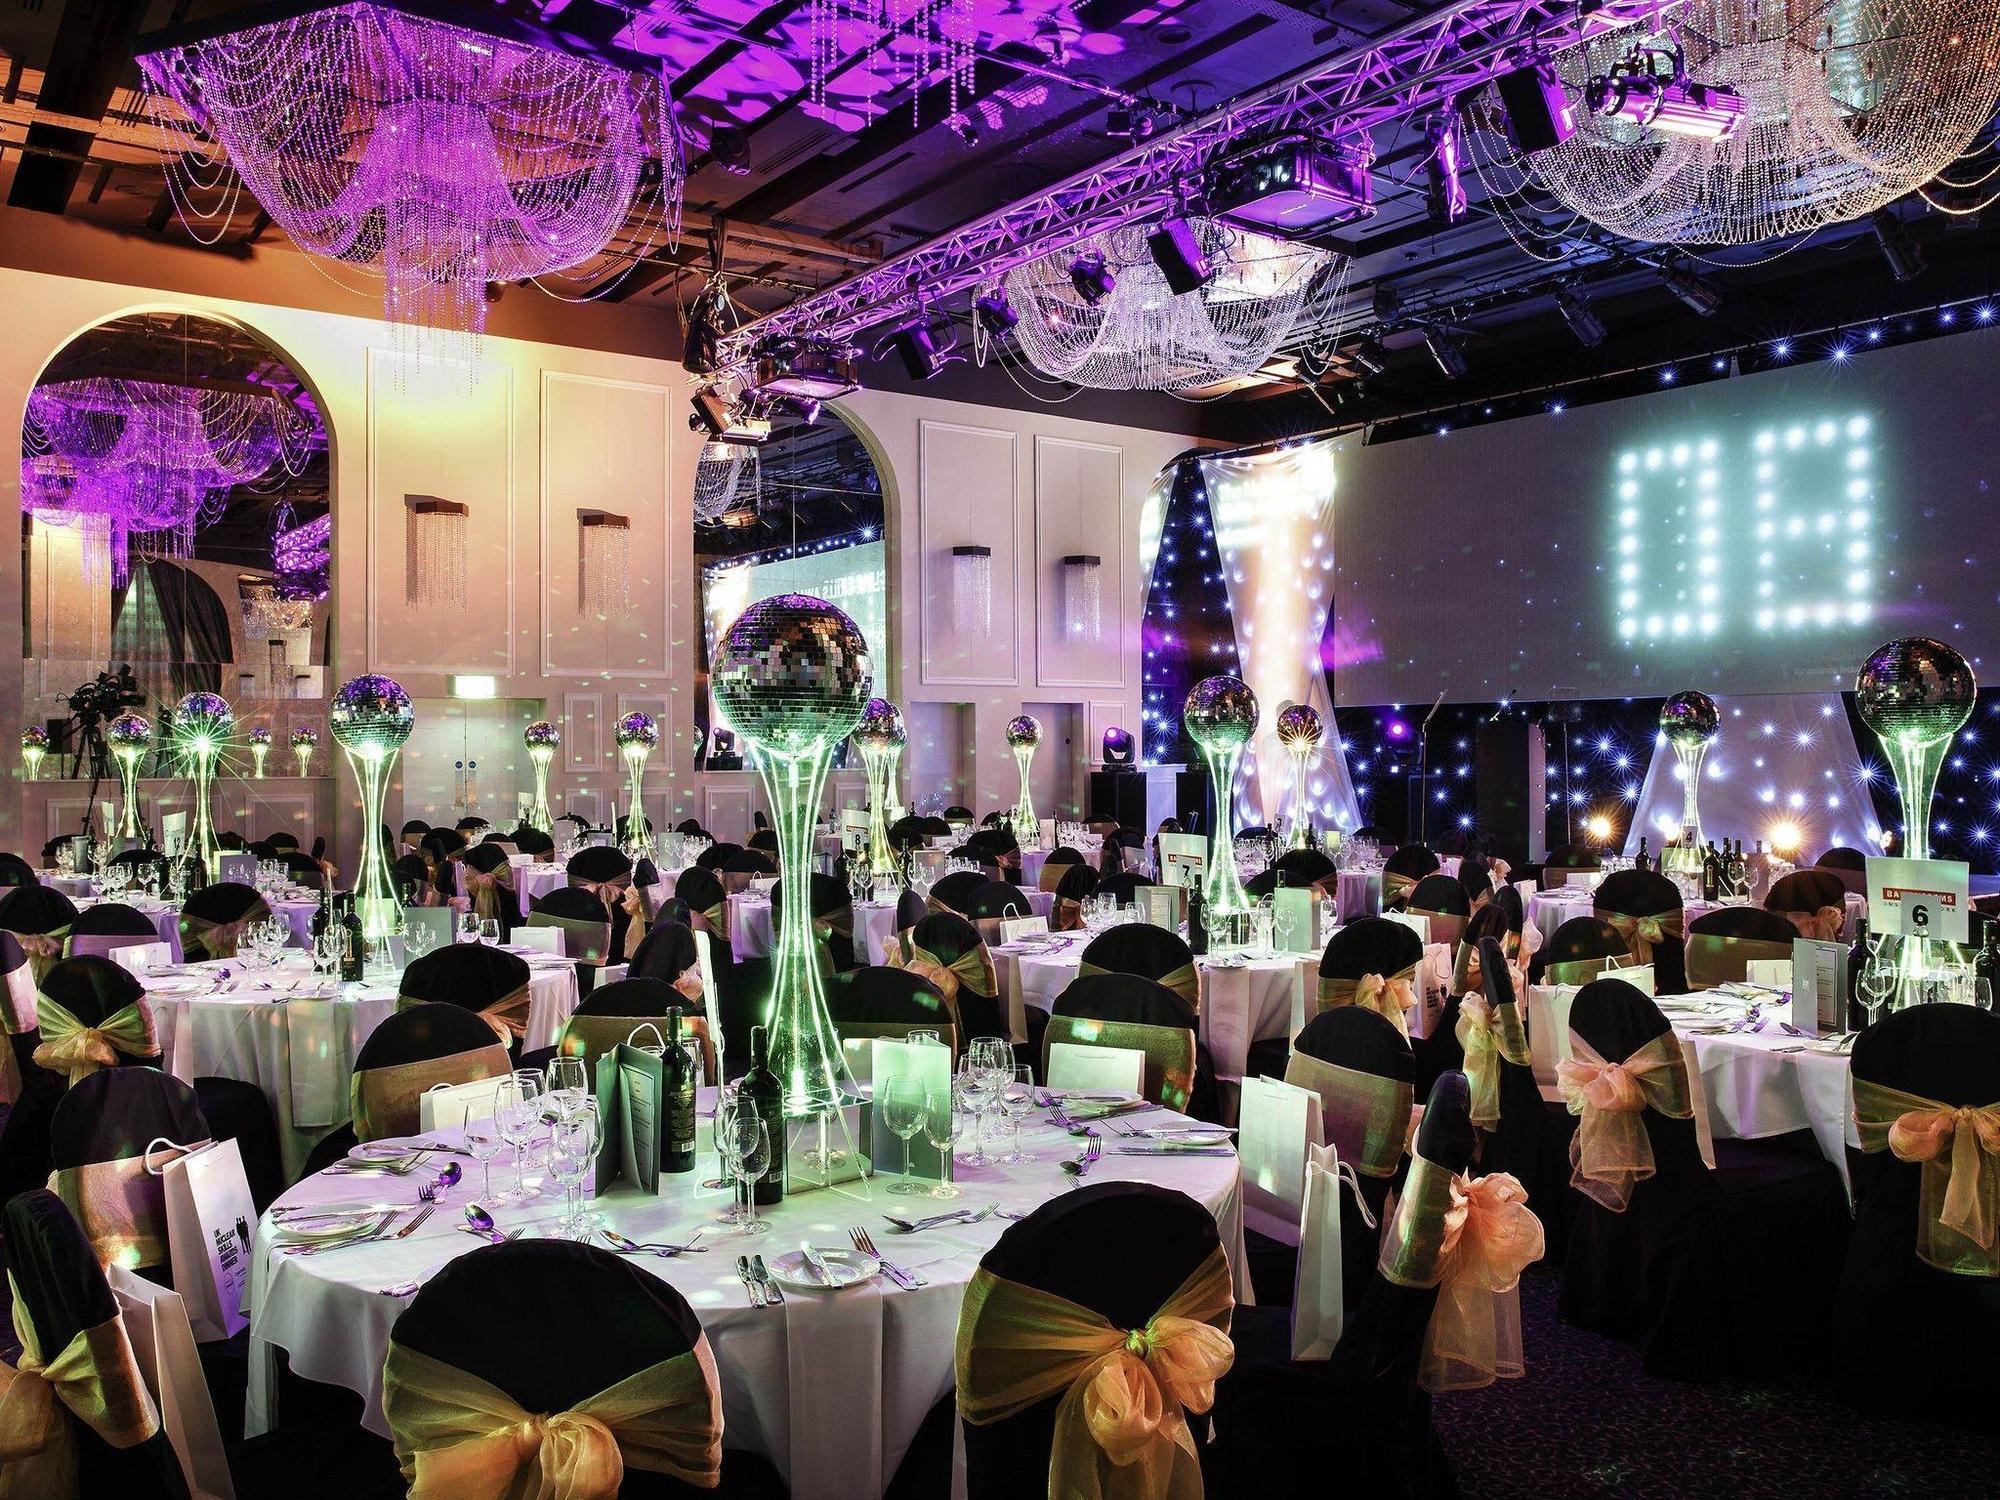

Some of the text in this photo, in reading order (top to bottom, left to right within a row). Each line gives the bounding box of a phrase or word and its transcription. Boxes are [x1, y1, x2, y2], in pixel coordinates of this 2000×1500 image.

[1618, 415, 1871, 636] 08
[855, 834, 861, 845] 8
[1686, 832, 1693, 842] 4
[1182, 864, 1190, 877] 7
[1912, 904, 1929, 926] 6
